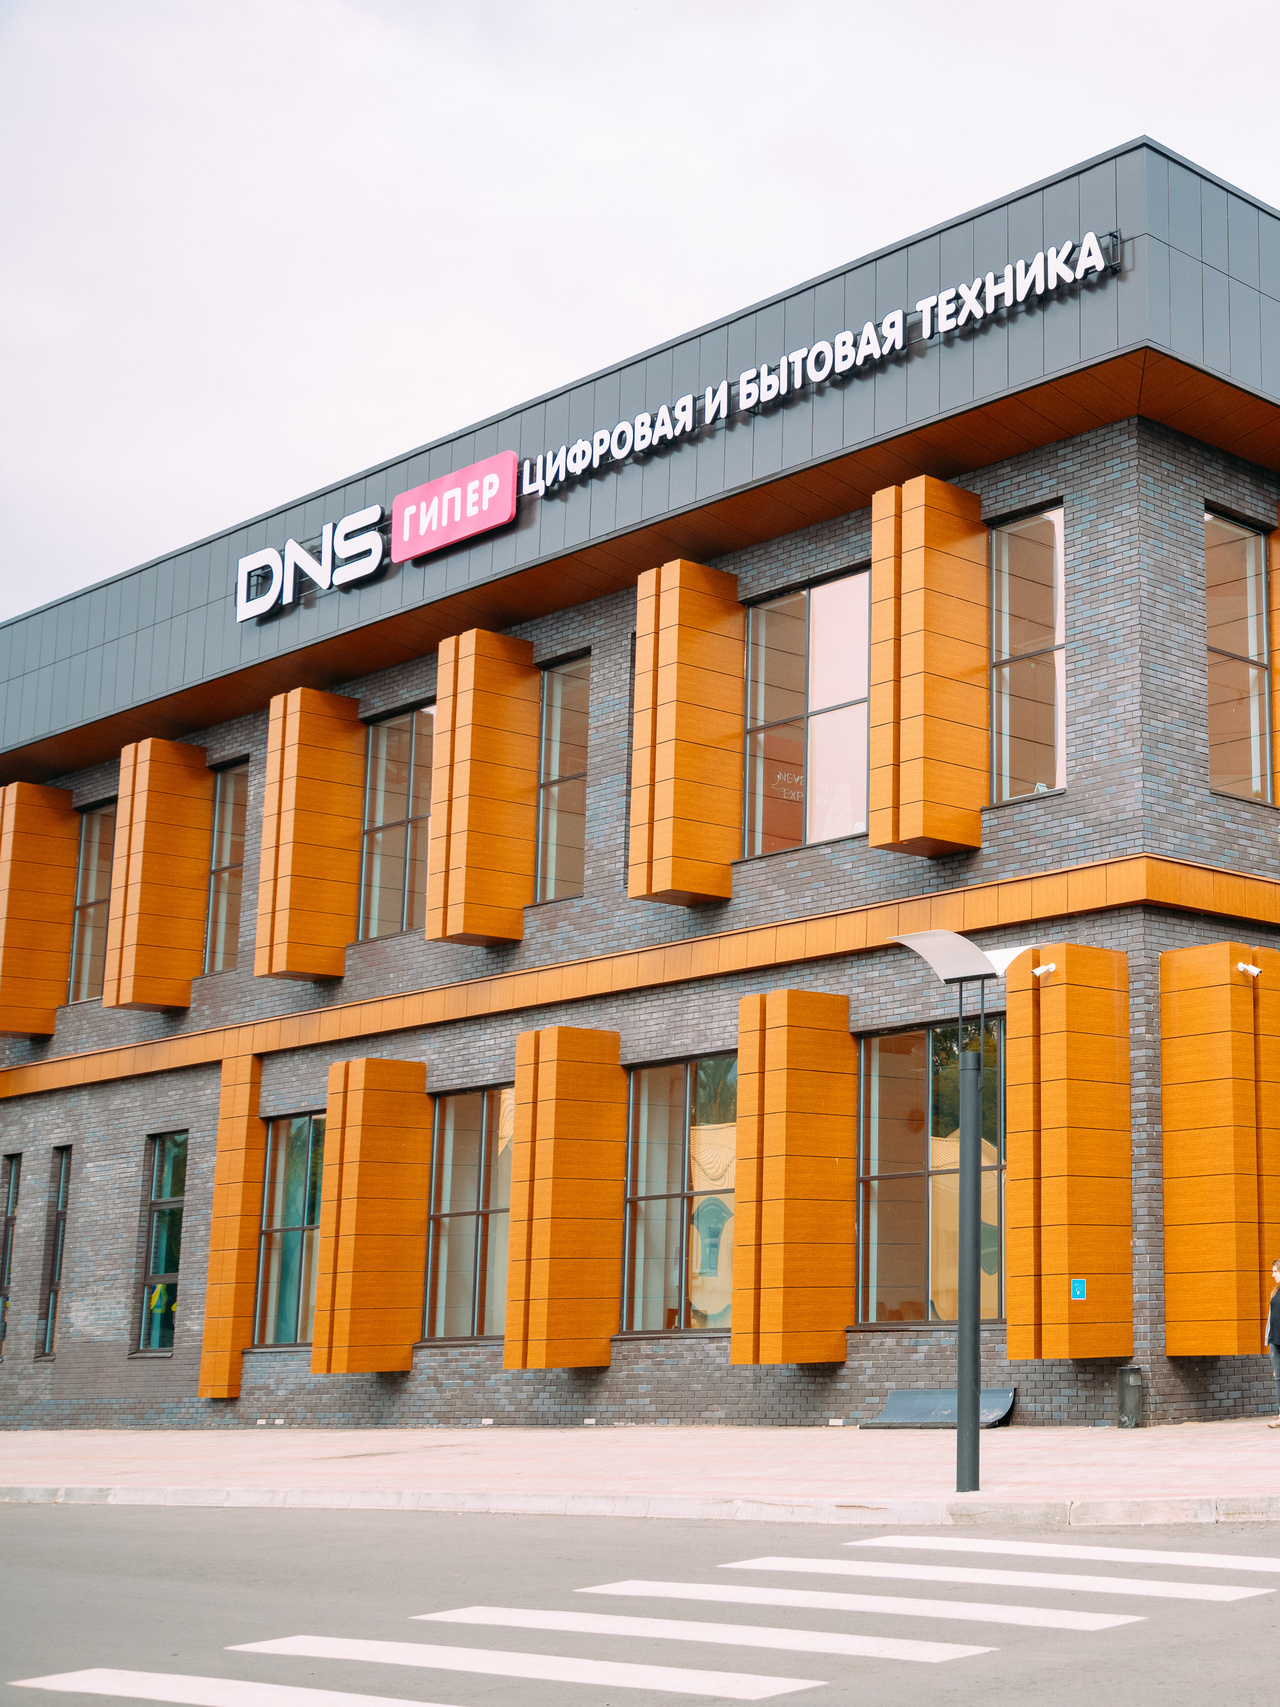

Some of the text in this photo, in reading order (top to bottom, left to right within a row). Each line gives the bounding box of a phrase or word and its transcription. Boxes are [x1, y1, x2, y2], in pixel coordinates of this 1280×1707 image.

[522, 230, 1106, 497] ЦИФРОВАЯ И БЫТОВАЯ ТЕХНИКА
[236, 504, 384, 623] DNS
[402, 473, 500, 542] ГИПЕР
